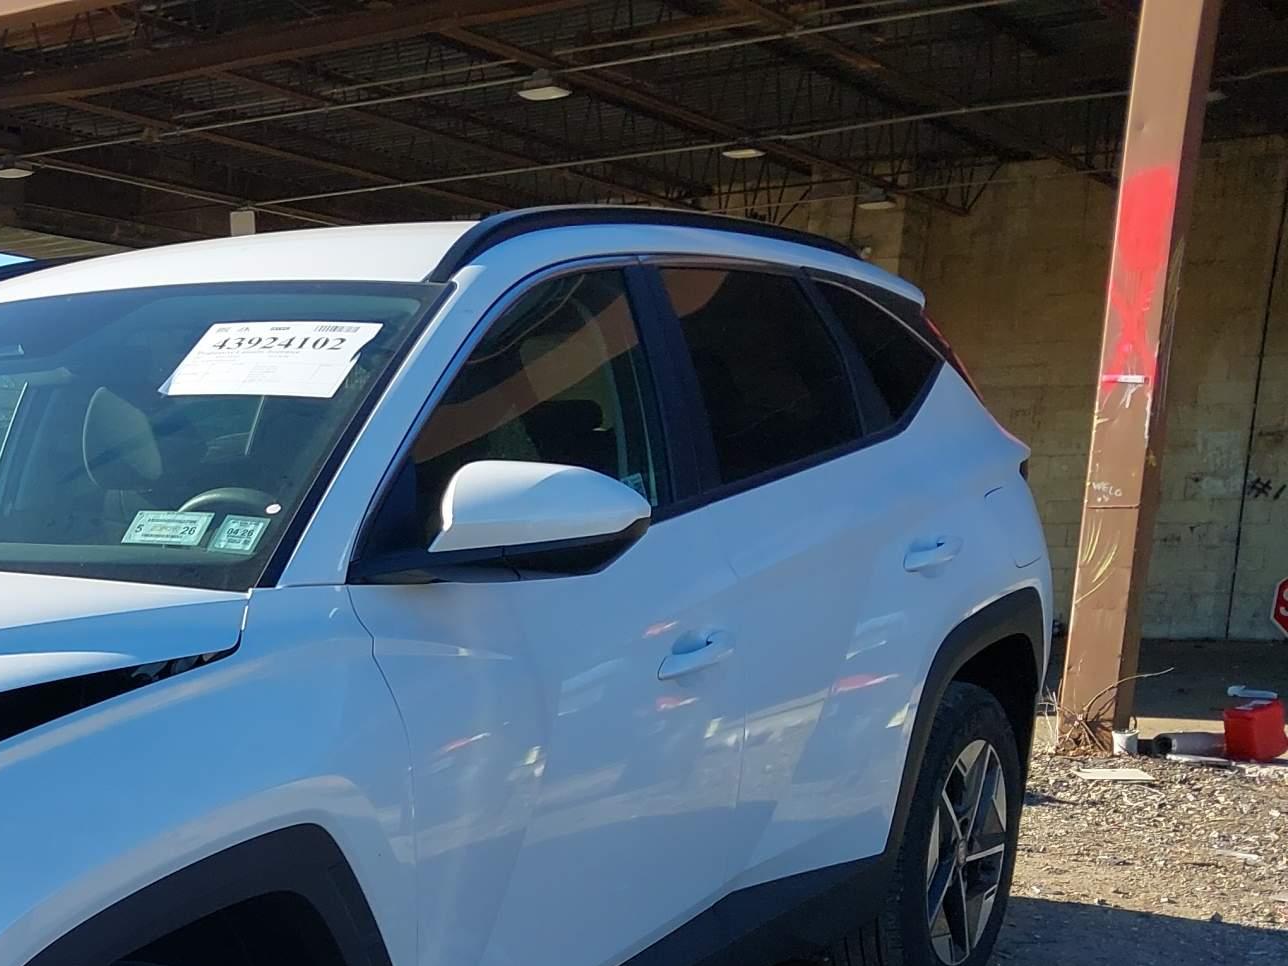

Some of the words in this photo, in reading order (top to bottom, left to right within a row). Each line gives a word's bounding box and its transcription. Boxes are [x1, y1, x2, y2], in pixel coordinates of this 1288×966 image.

[212, 336, 347, 350] 43924102
[134, 524, 144, 533] 5
[180, 526, 197, 536] 26
[240, 529, 254, 537] 26
